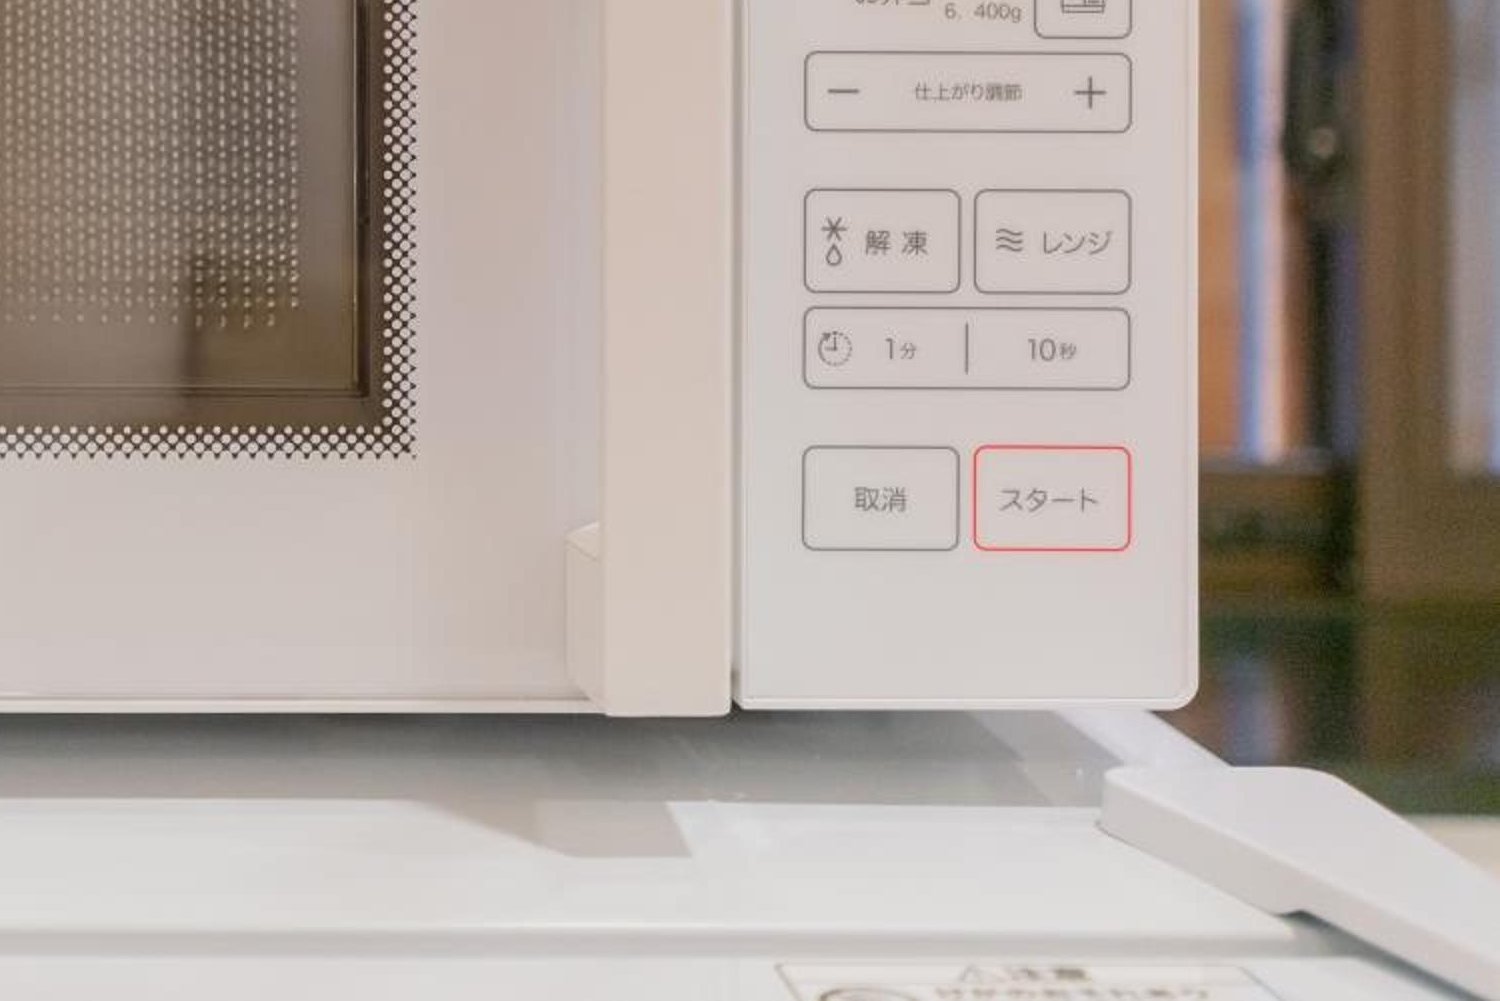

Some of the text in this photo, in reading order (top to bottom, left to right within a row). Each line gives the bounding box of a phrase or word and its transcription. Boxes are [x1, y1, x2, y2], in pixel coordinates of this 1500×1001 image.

[973, 2, 1023, 24] 400g
[1042, 230, 1112, 256] レンジ
[854, 486, 907, 513] 取消
[1001, 488, 1098, 513] スタート
